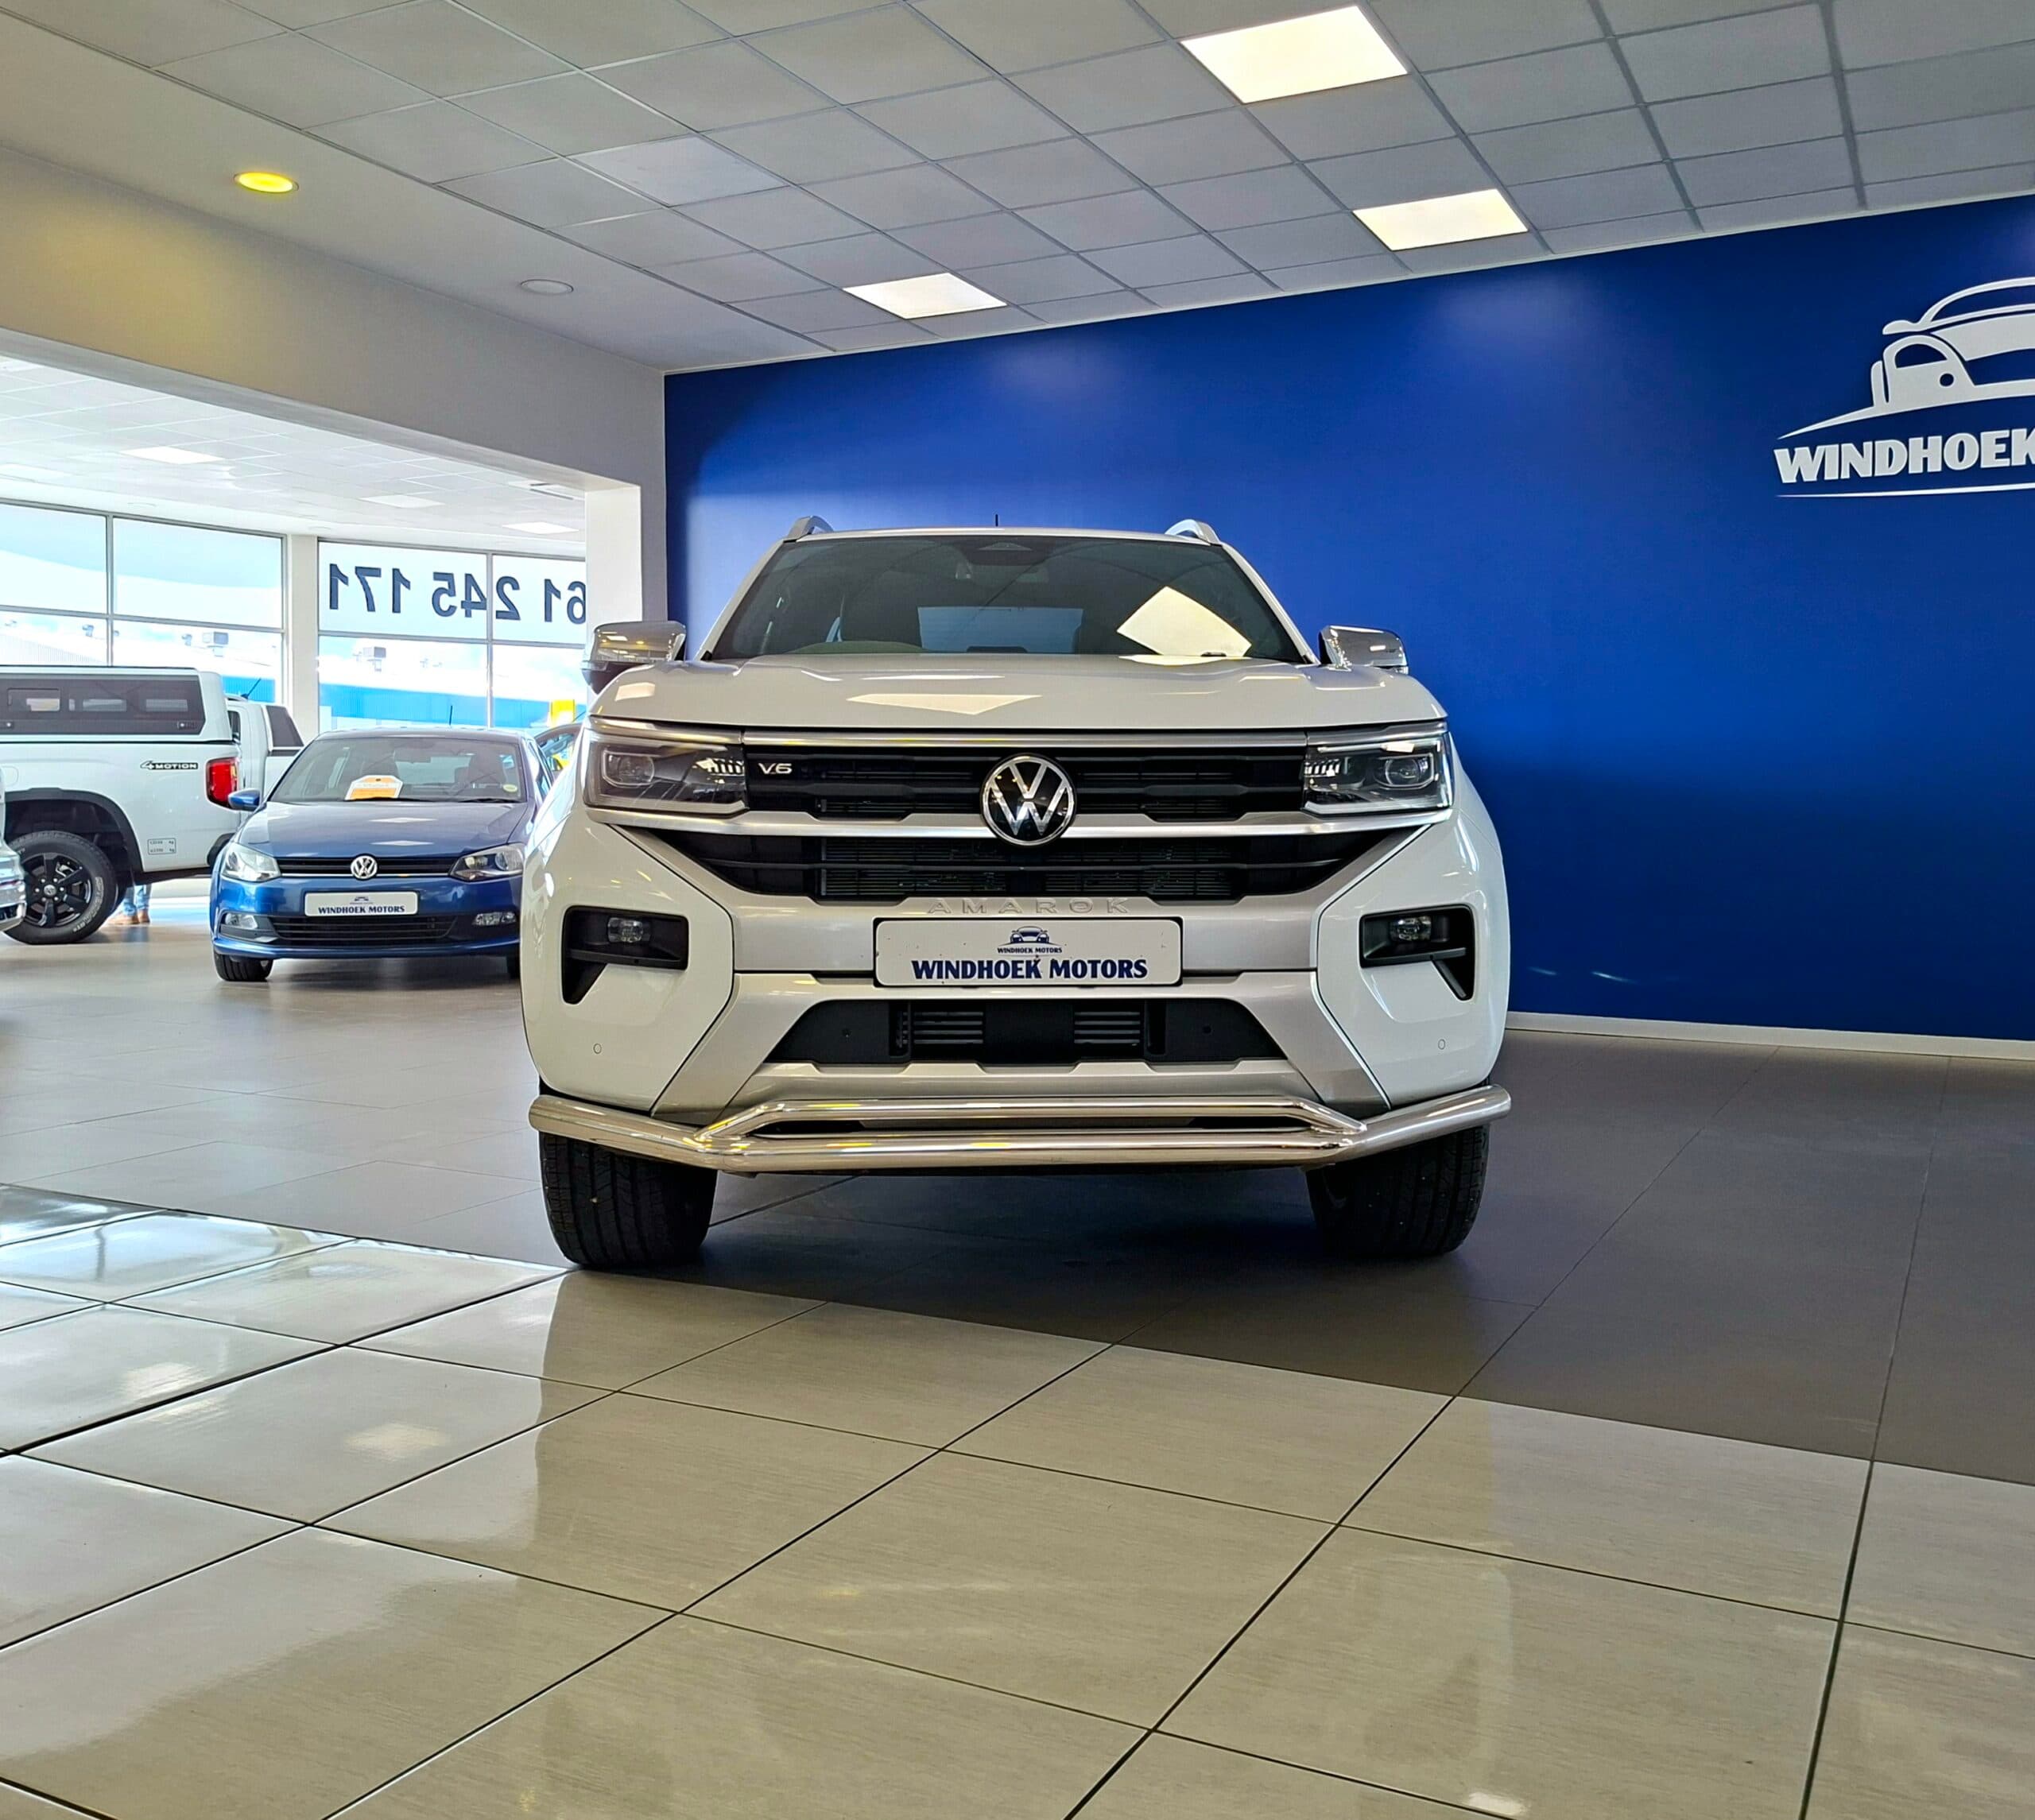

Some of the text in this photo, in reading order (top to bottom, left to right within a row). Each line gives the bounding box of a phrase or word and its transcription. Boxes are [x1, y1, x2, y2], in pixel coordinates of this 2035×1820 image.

[140, 761, 198, 770] 4MOTION
[758, 763, 793, 774] V6
[928, 897, 1128, 914] AMAROK
[911, 958, 1148, 979] WINDHOEK MOTORS
